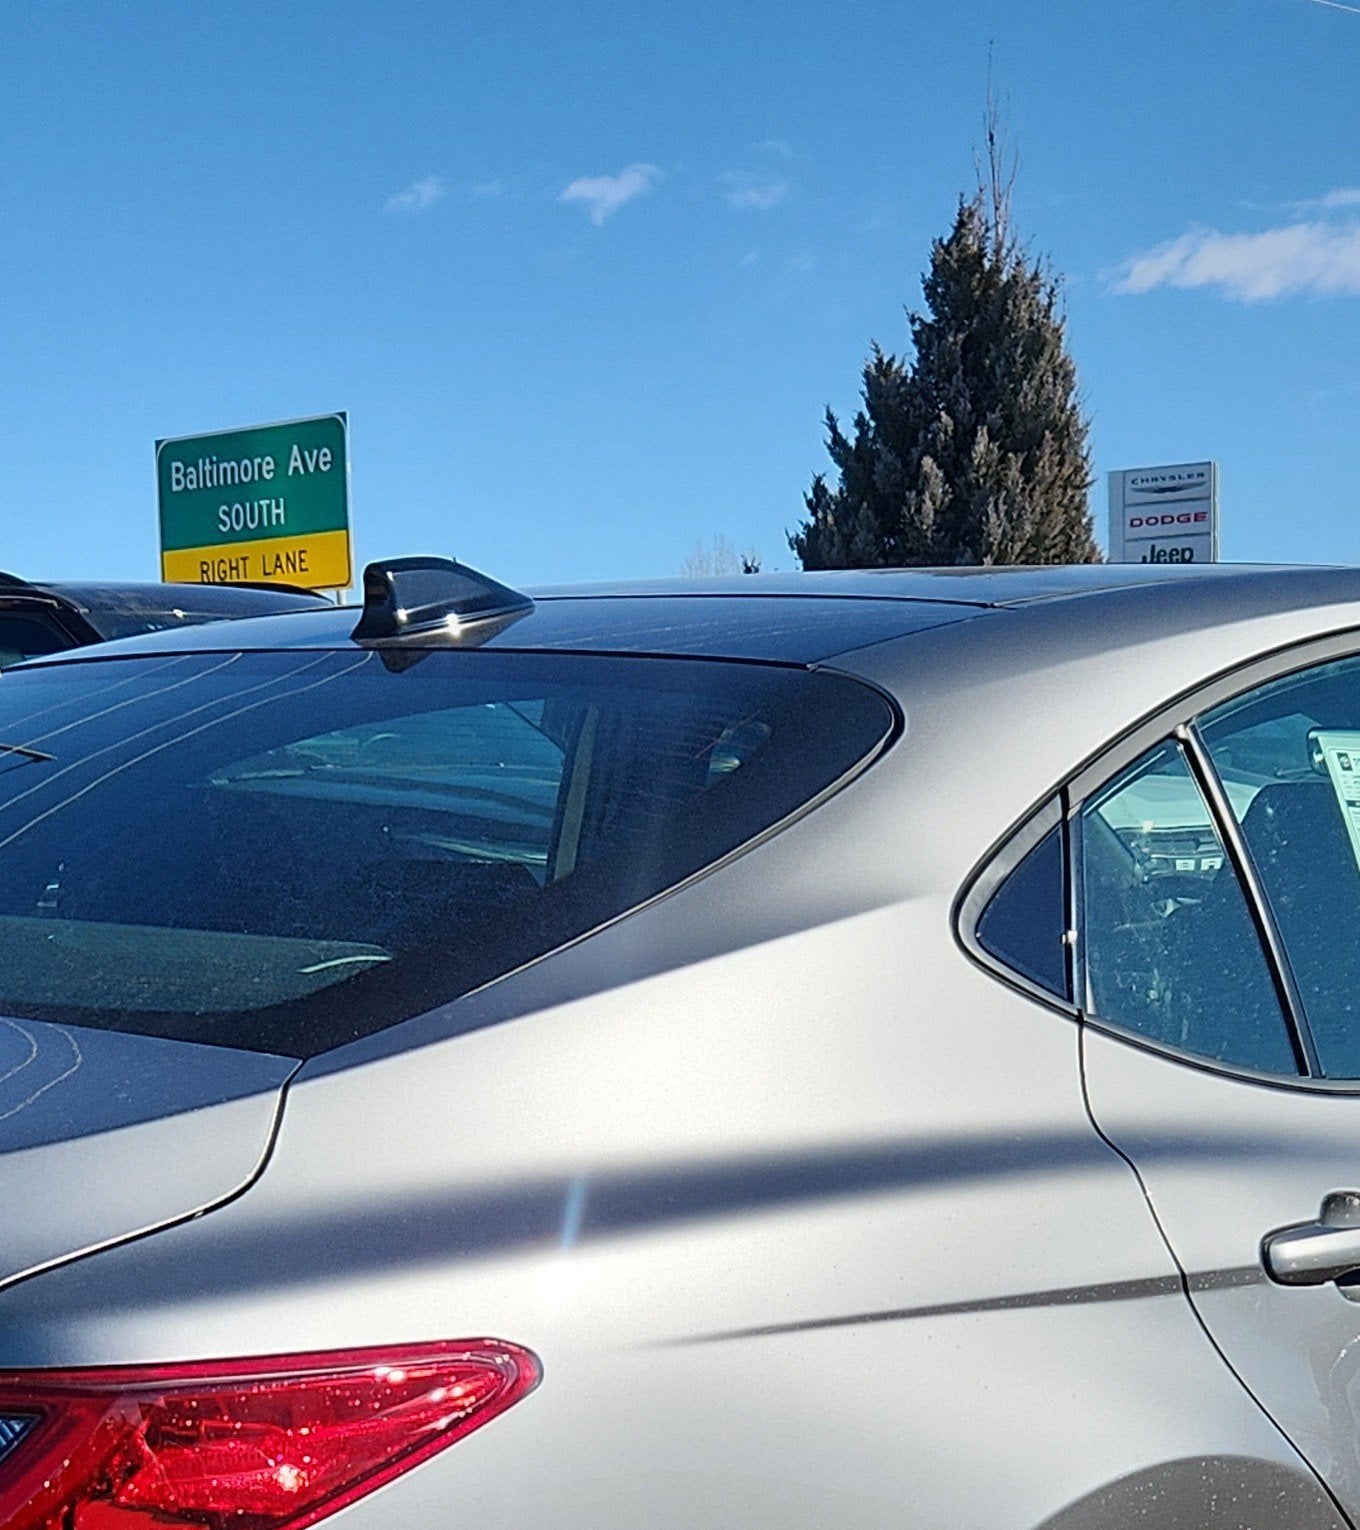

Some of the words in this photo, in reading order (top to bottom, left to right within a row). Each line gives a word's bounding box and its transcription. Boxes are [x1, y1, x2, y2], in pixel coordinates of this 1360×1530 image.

[171, 455, 275, 492] Baltimore
[287, 443, 333, 477] Ave
[1130, 472, 1206, 486] CHRYSLER
[217, 497, 286, 532] SOUTH
[1129, 511, 1208, 528] DODGE
[199, 555, 250, 583] RIGHT
[261, 549, 310, 577] LANE
[1141, 544, 1195, 564] Jeep
